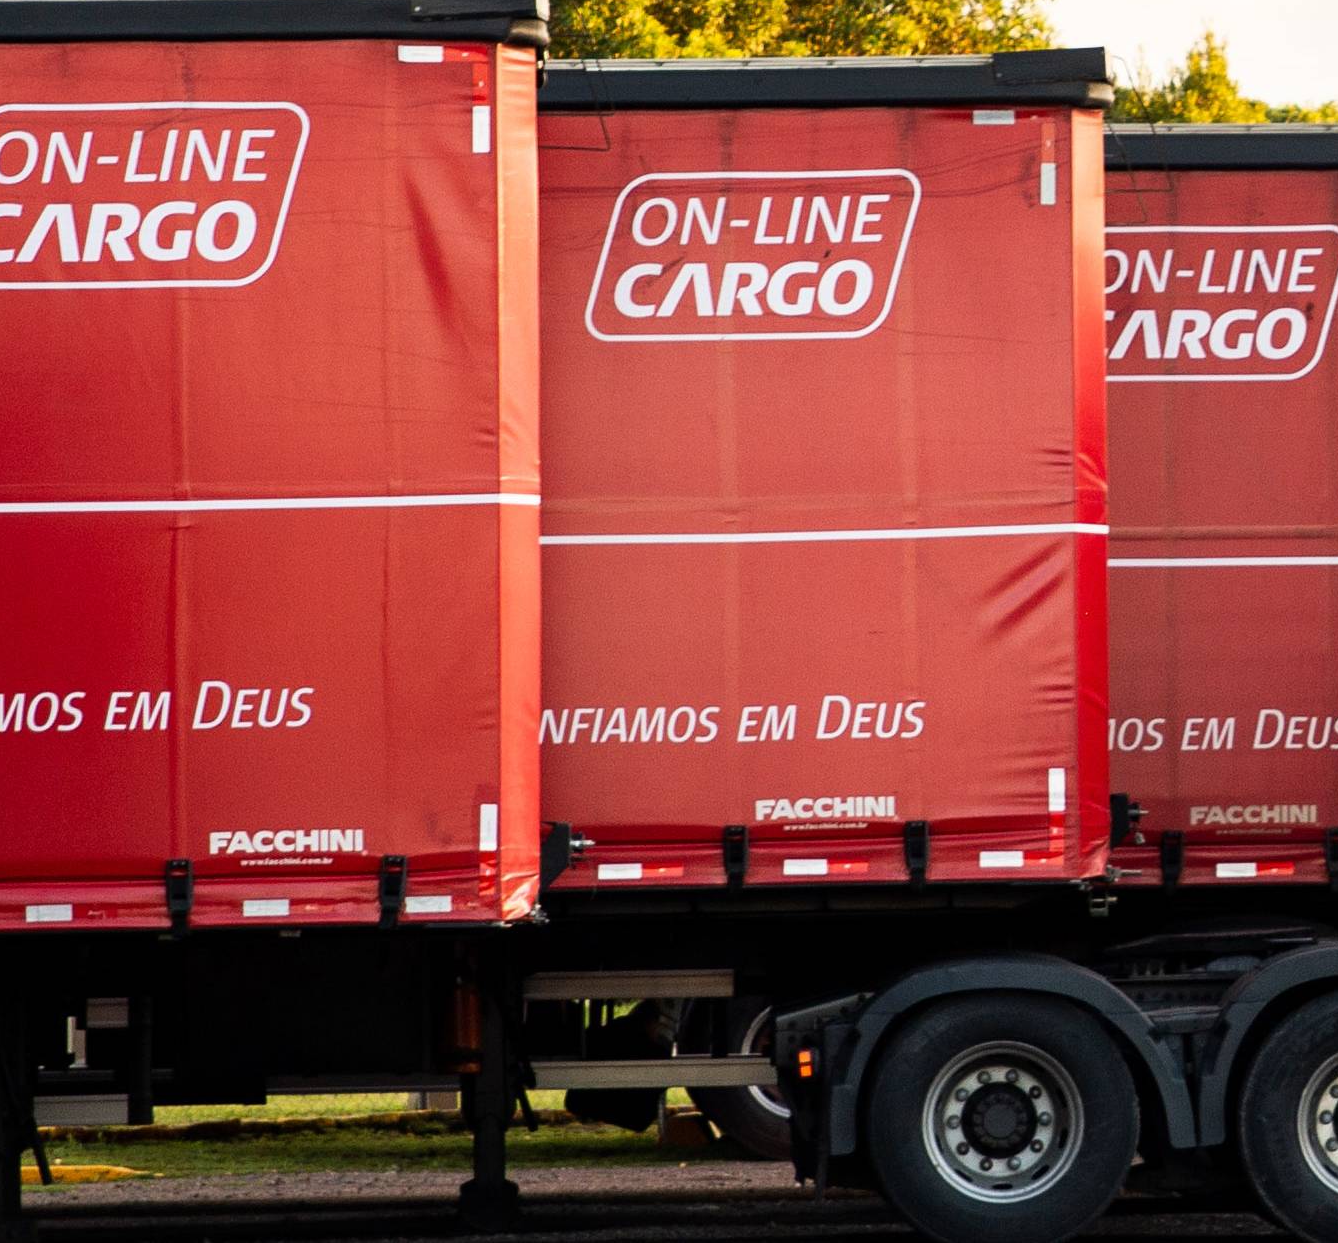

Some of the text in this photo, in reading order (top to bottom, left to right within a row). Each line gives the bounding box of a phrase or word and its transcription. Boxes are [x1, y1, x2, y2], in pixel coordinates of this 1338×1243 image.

[632, 194, 891, 246] ON-LINE
[613, 260, 874, 318] CARGO
[1105, 307, 1308, 360] ARGO
[103, 690, 172, 731] EM
[539, 705, 721, 744] NFIAMOS
[736, 704, 797, 743] EM
[1108, 717, 1166, 752] OS
[1180, 717, 1236, 751] EM
[754, 796, 896, 821] FACCHINI
[1189, 804, 1318, 826] FACCHINI
[209, 828, 364, 855] FACCHINI
